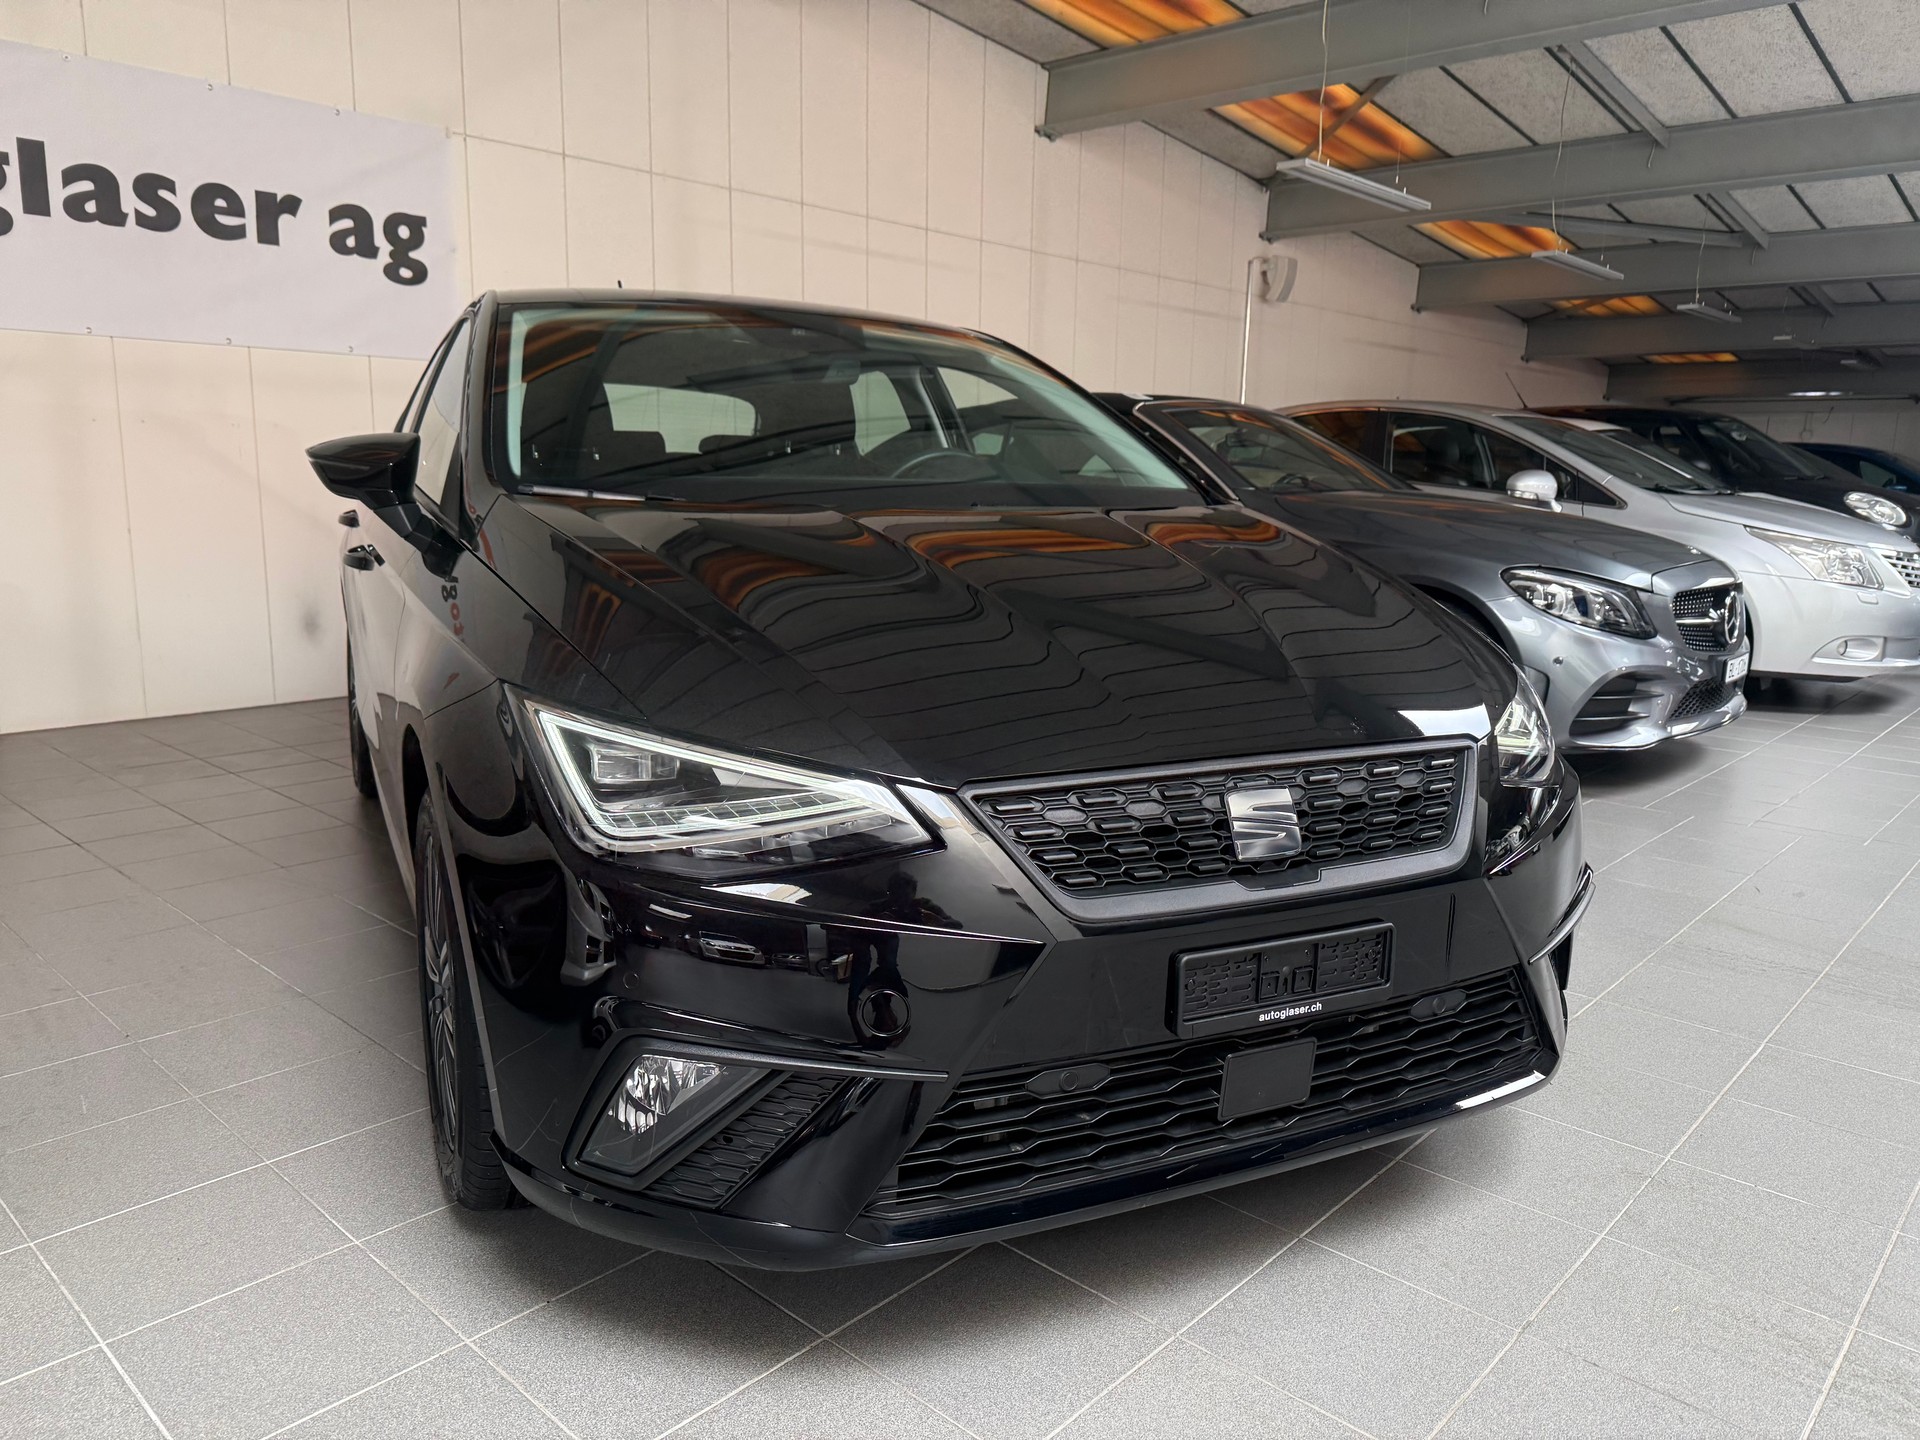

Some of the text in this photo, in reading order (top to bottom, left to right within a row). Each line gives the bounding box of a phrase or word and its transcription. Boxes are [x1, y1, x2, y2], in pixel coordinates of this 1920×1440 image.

[0, 137, 429, 286] laser ag
[1258, 1001, 1323, 1022] autoglaser.ch
